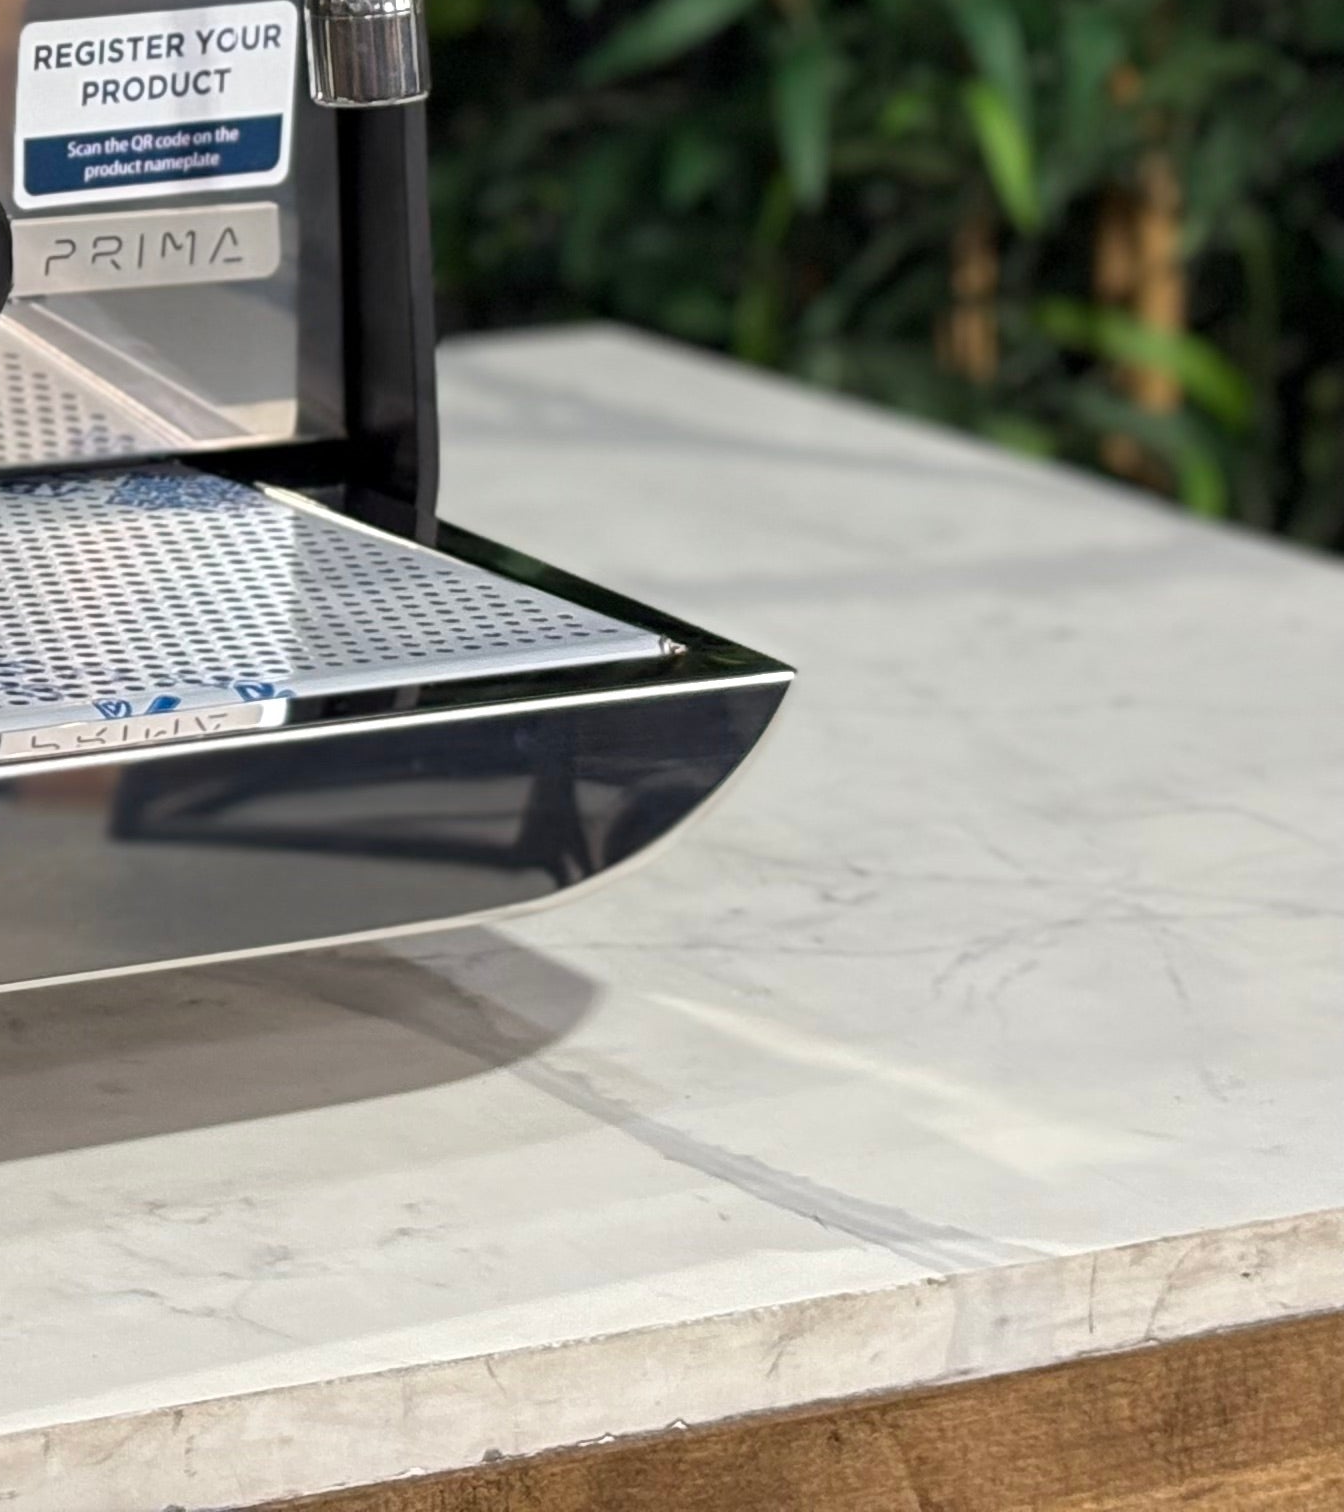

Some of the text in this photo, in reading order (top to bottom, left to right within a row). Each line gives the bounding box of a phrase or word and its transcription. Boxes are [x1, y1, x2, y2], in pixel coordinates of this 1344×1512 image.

[33, 24, 282, 71] REGISTER YOUR
[81, 68, 232, 106] PRODUCT
[67, 125, 240, 159] Scan the QR code on the
[83, 152, 221, 183] product nameplate
[43, 226, 244, 277] PRIMA
